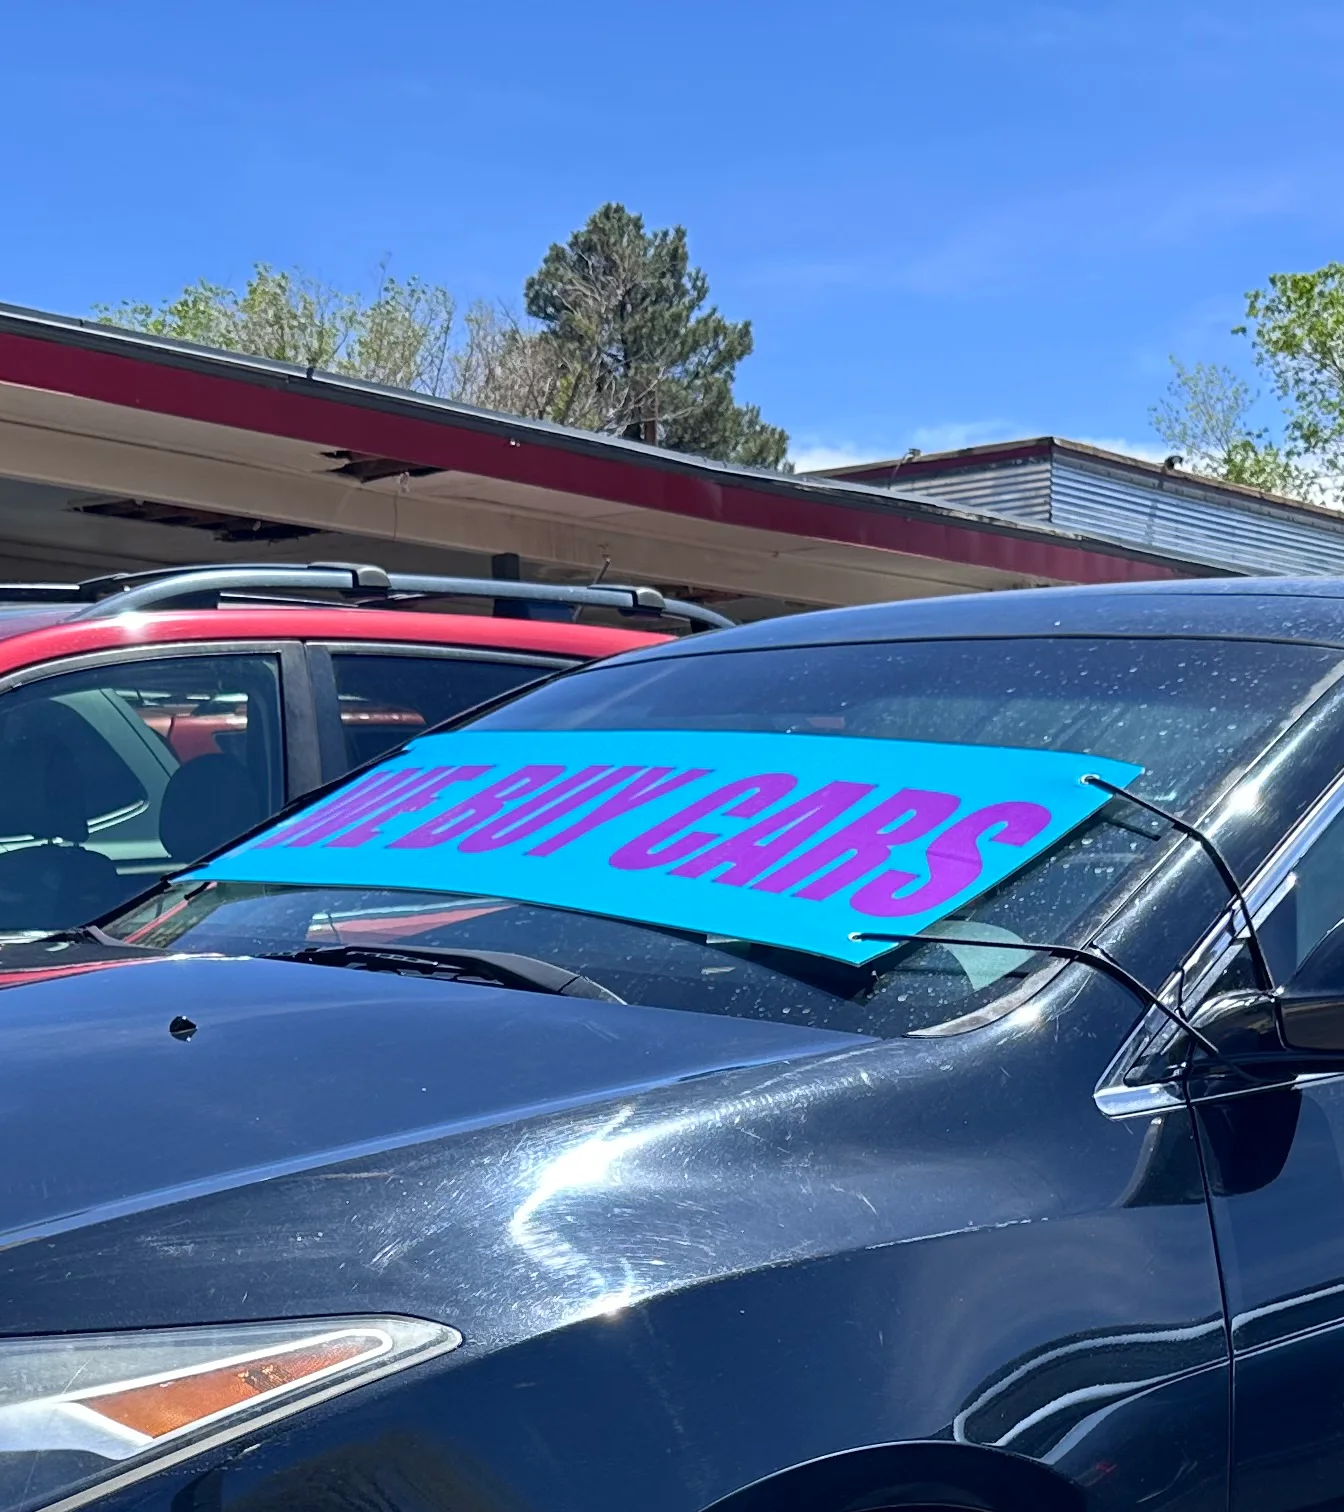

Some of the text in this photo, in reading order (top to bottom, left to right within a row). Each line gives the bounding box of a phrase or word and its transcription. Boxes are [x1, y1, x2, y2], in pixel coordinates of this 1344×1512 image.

[252, 764, 1053, 918] WE BUY CARS
